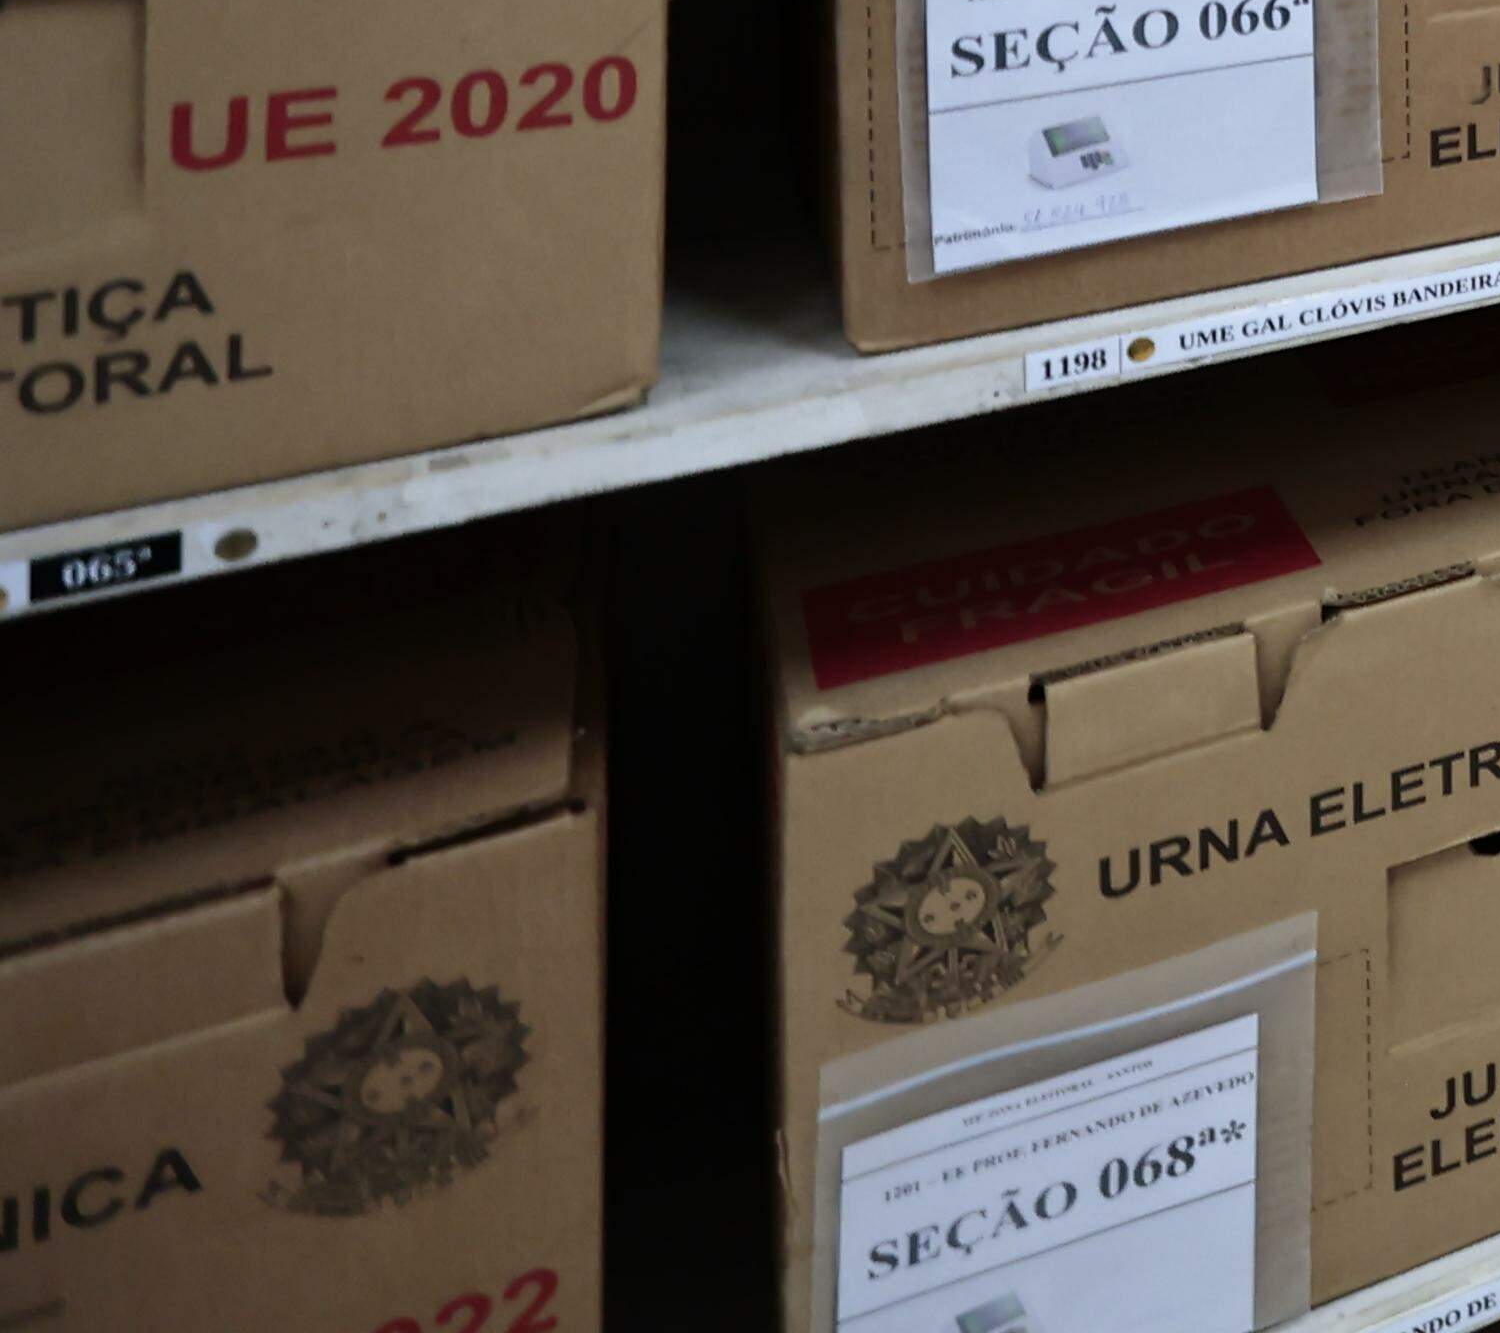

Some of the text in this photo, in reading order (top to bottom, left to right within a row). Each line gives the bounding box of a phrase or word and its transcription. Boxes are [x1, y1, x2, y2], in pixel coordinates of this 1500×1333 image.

[951, 5, 1179, 79] SEÇÃO
[169, 56, 639, 173] UE 2020
[1097, 808, 1289, 902] URNA
[867, 1187, 1078, 1281] SEÇÃO
